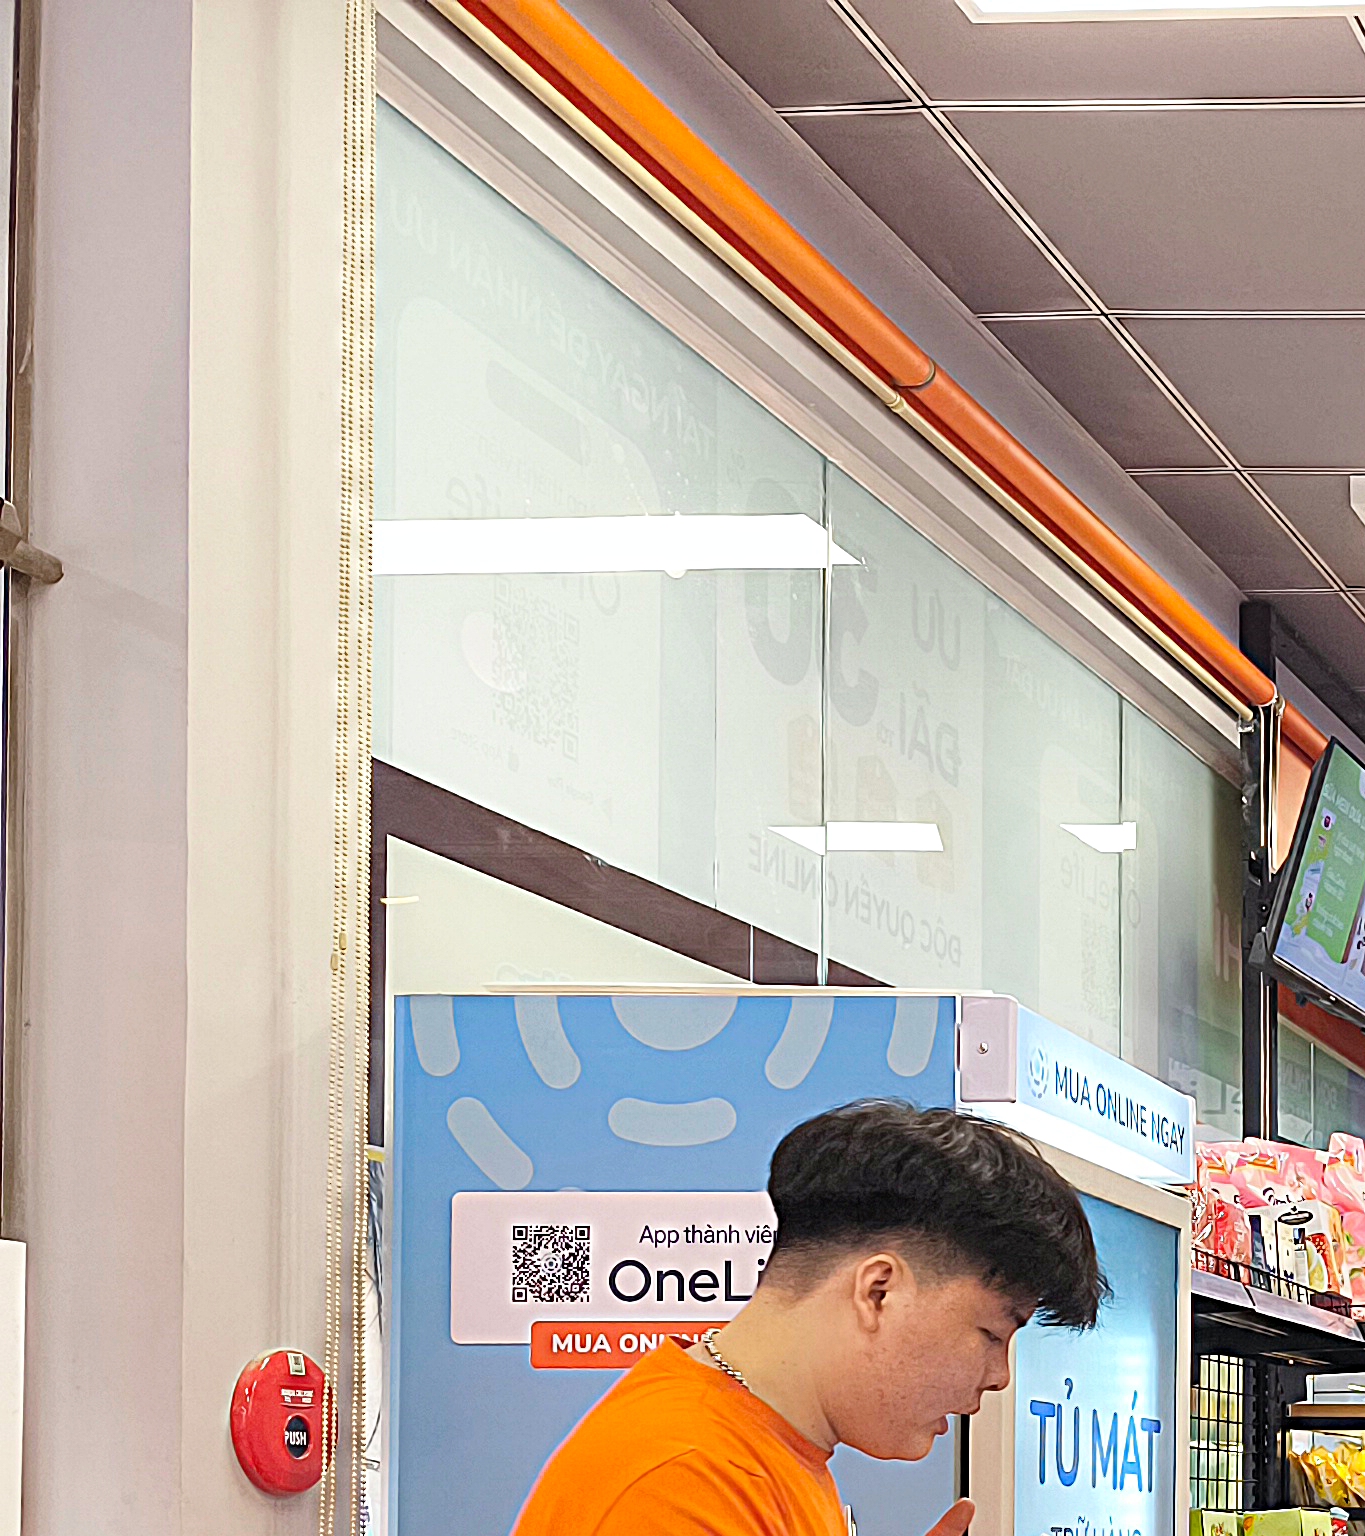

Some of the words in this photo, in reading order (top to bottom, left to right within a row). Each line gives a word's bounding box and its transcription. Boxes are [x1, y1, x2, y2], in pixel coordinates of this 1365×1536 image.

[1055, 1061, 1091, 1110] MUA
[1096, 1083, 1147, 1137] ONLINE
[1151, 1111, 1185, 1155] NGAY
[639, 1225, 680, 1248] App
[684, 1224, 740, 1244] thành
[609, 1259, 767, 1302] OneLi
[551, 1334, 611, 1353] MUA
[284, 1430, 307, 1445] PUSH
[1030, 1378, 1078, 1489] TỦ
[1092, 1391, 1161, 1494] MÁT
